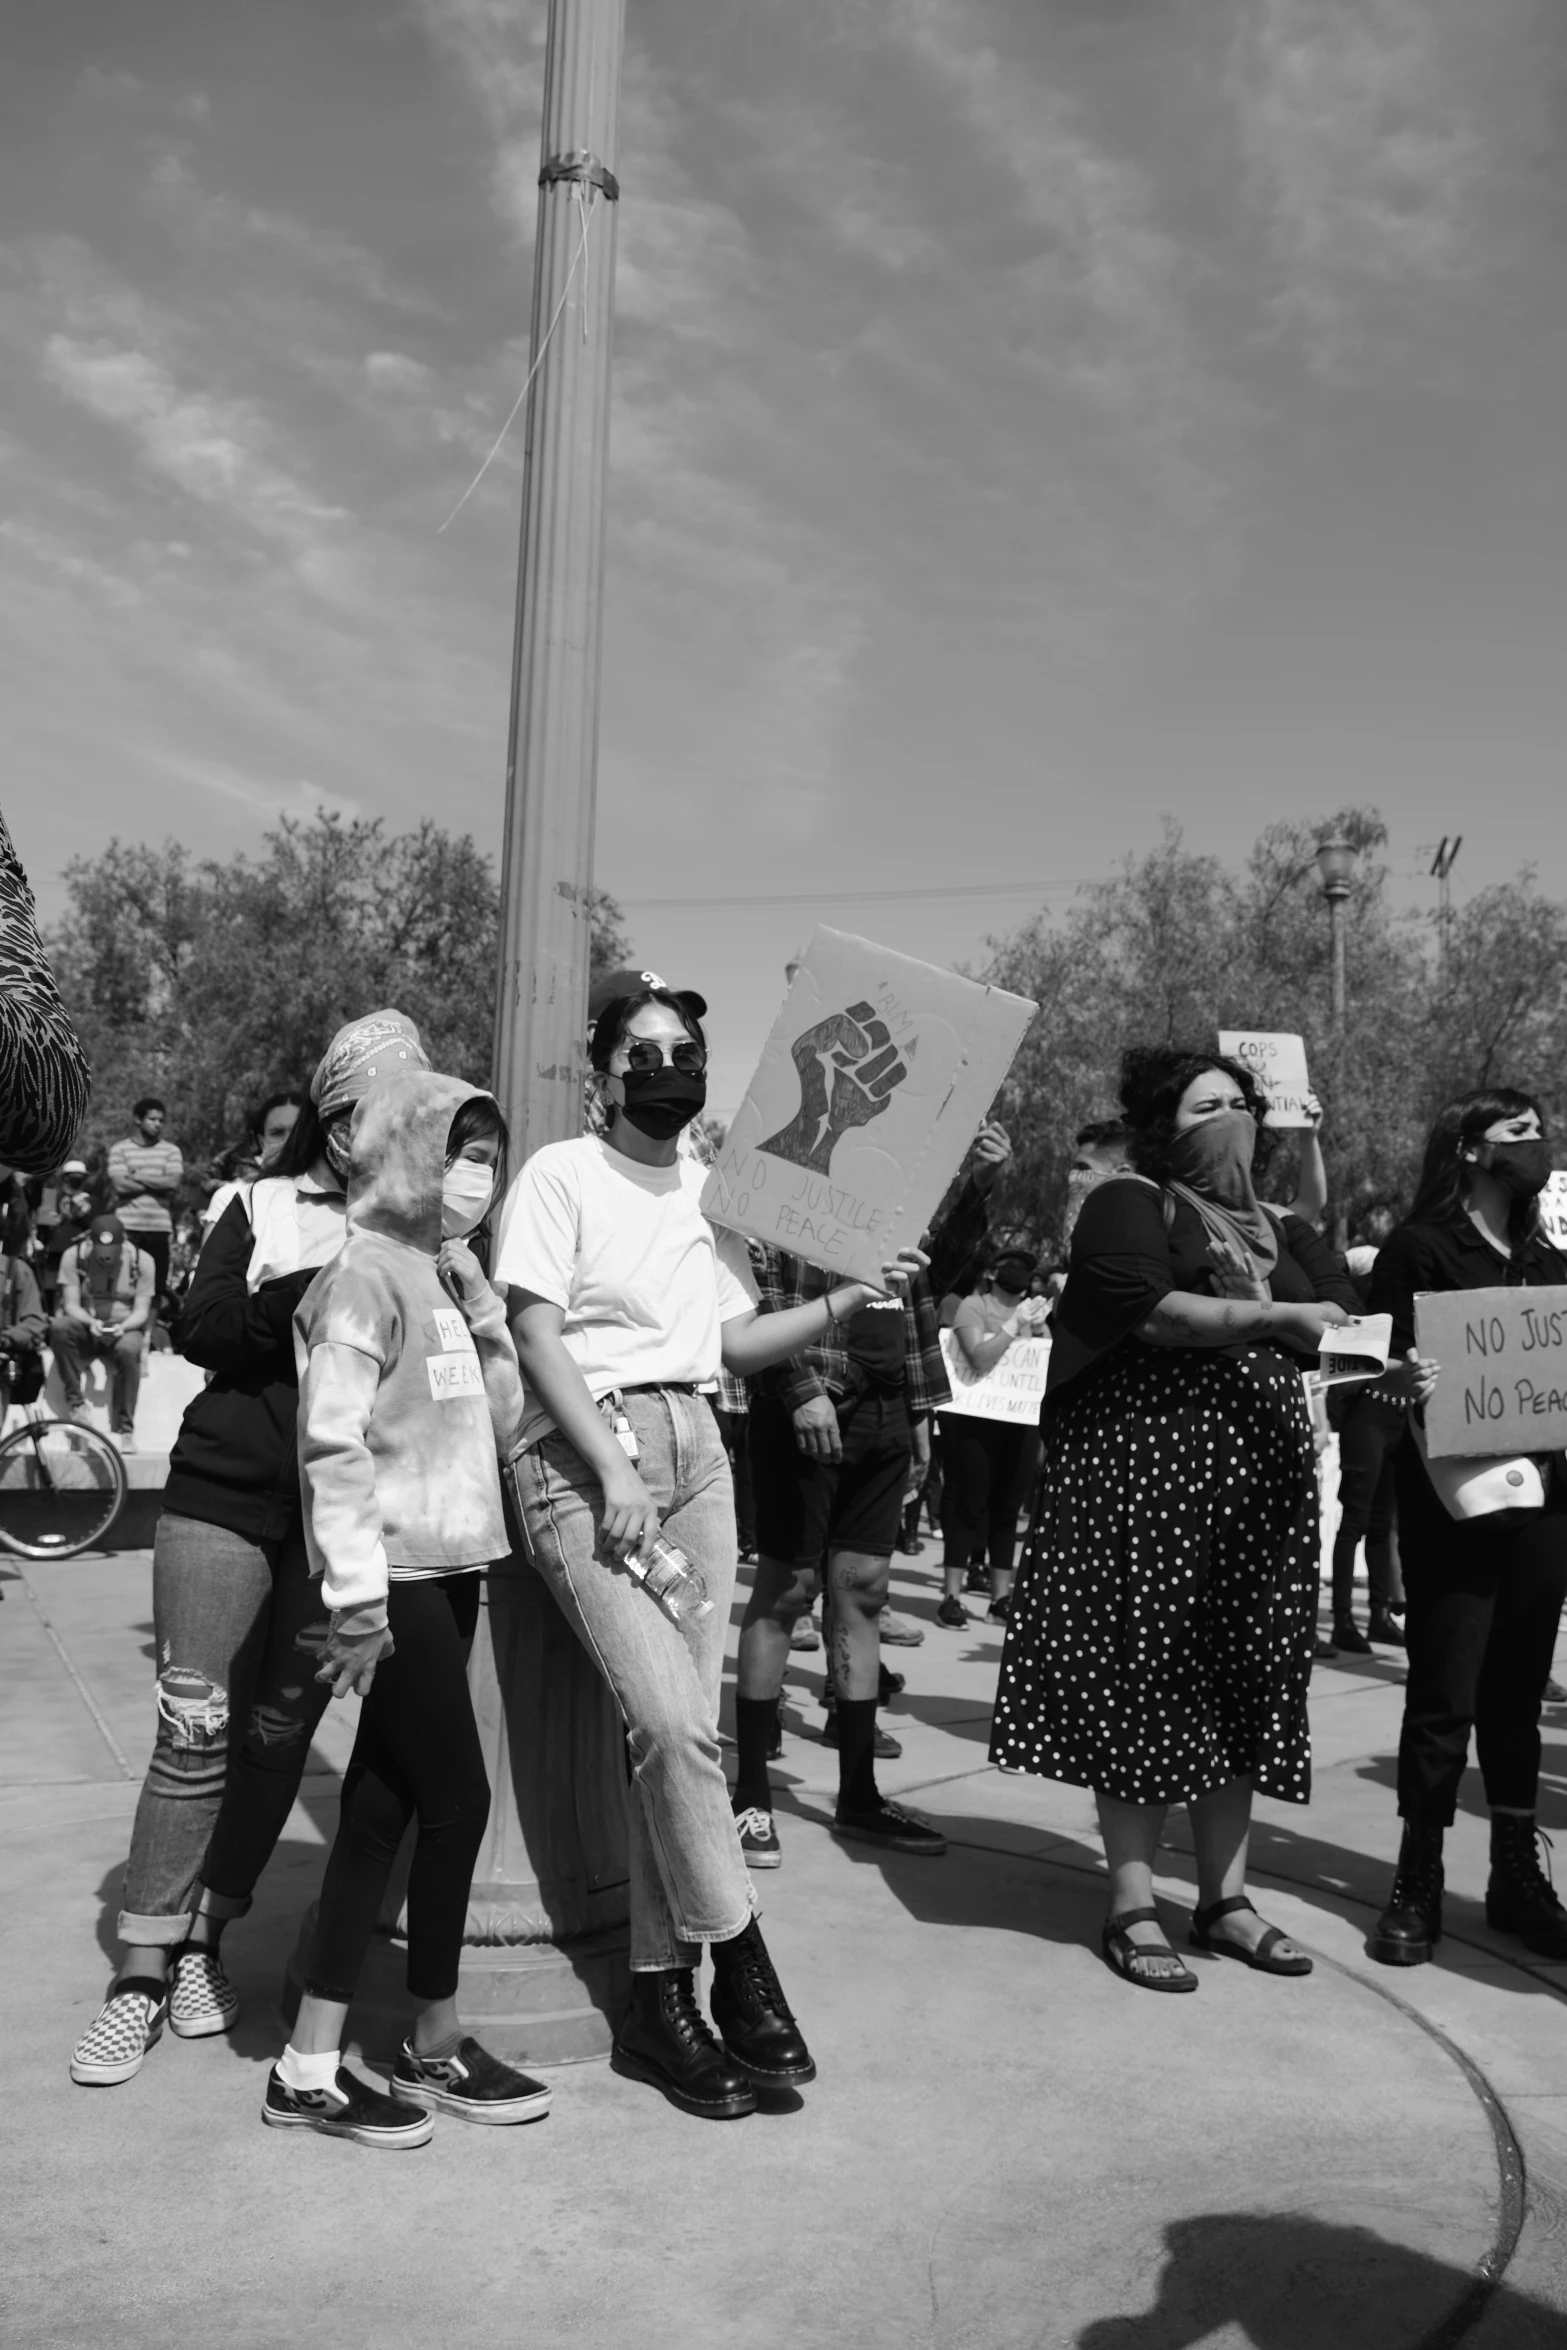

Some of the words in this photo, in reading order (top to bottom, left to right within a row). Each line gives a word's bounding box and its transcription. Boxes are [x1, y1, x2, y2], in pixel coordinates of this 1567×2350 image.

[1239, 1042, 1278, 1057] COPS
[721, 1148, 767, 1191] NO
[792, 1175, 884, 1232] JUSTICE
[707, 1184, 750, 1217] NO
[776, 1204, 848, 1255] PEACE
[1465, 1317, 1505, 1357] NO
[1464, 1374, 1505, 1425] NO
